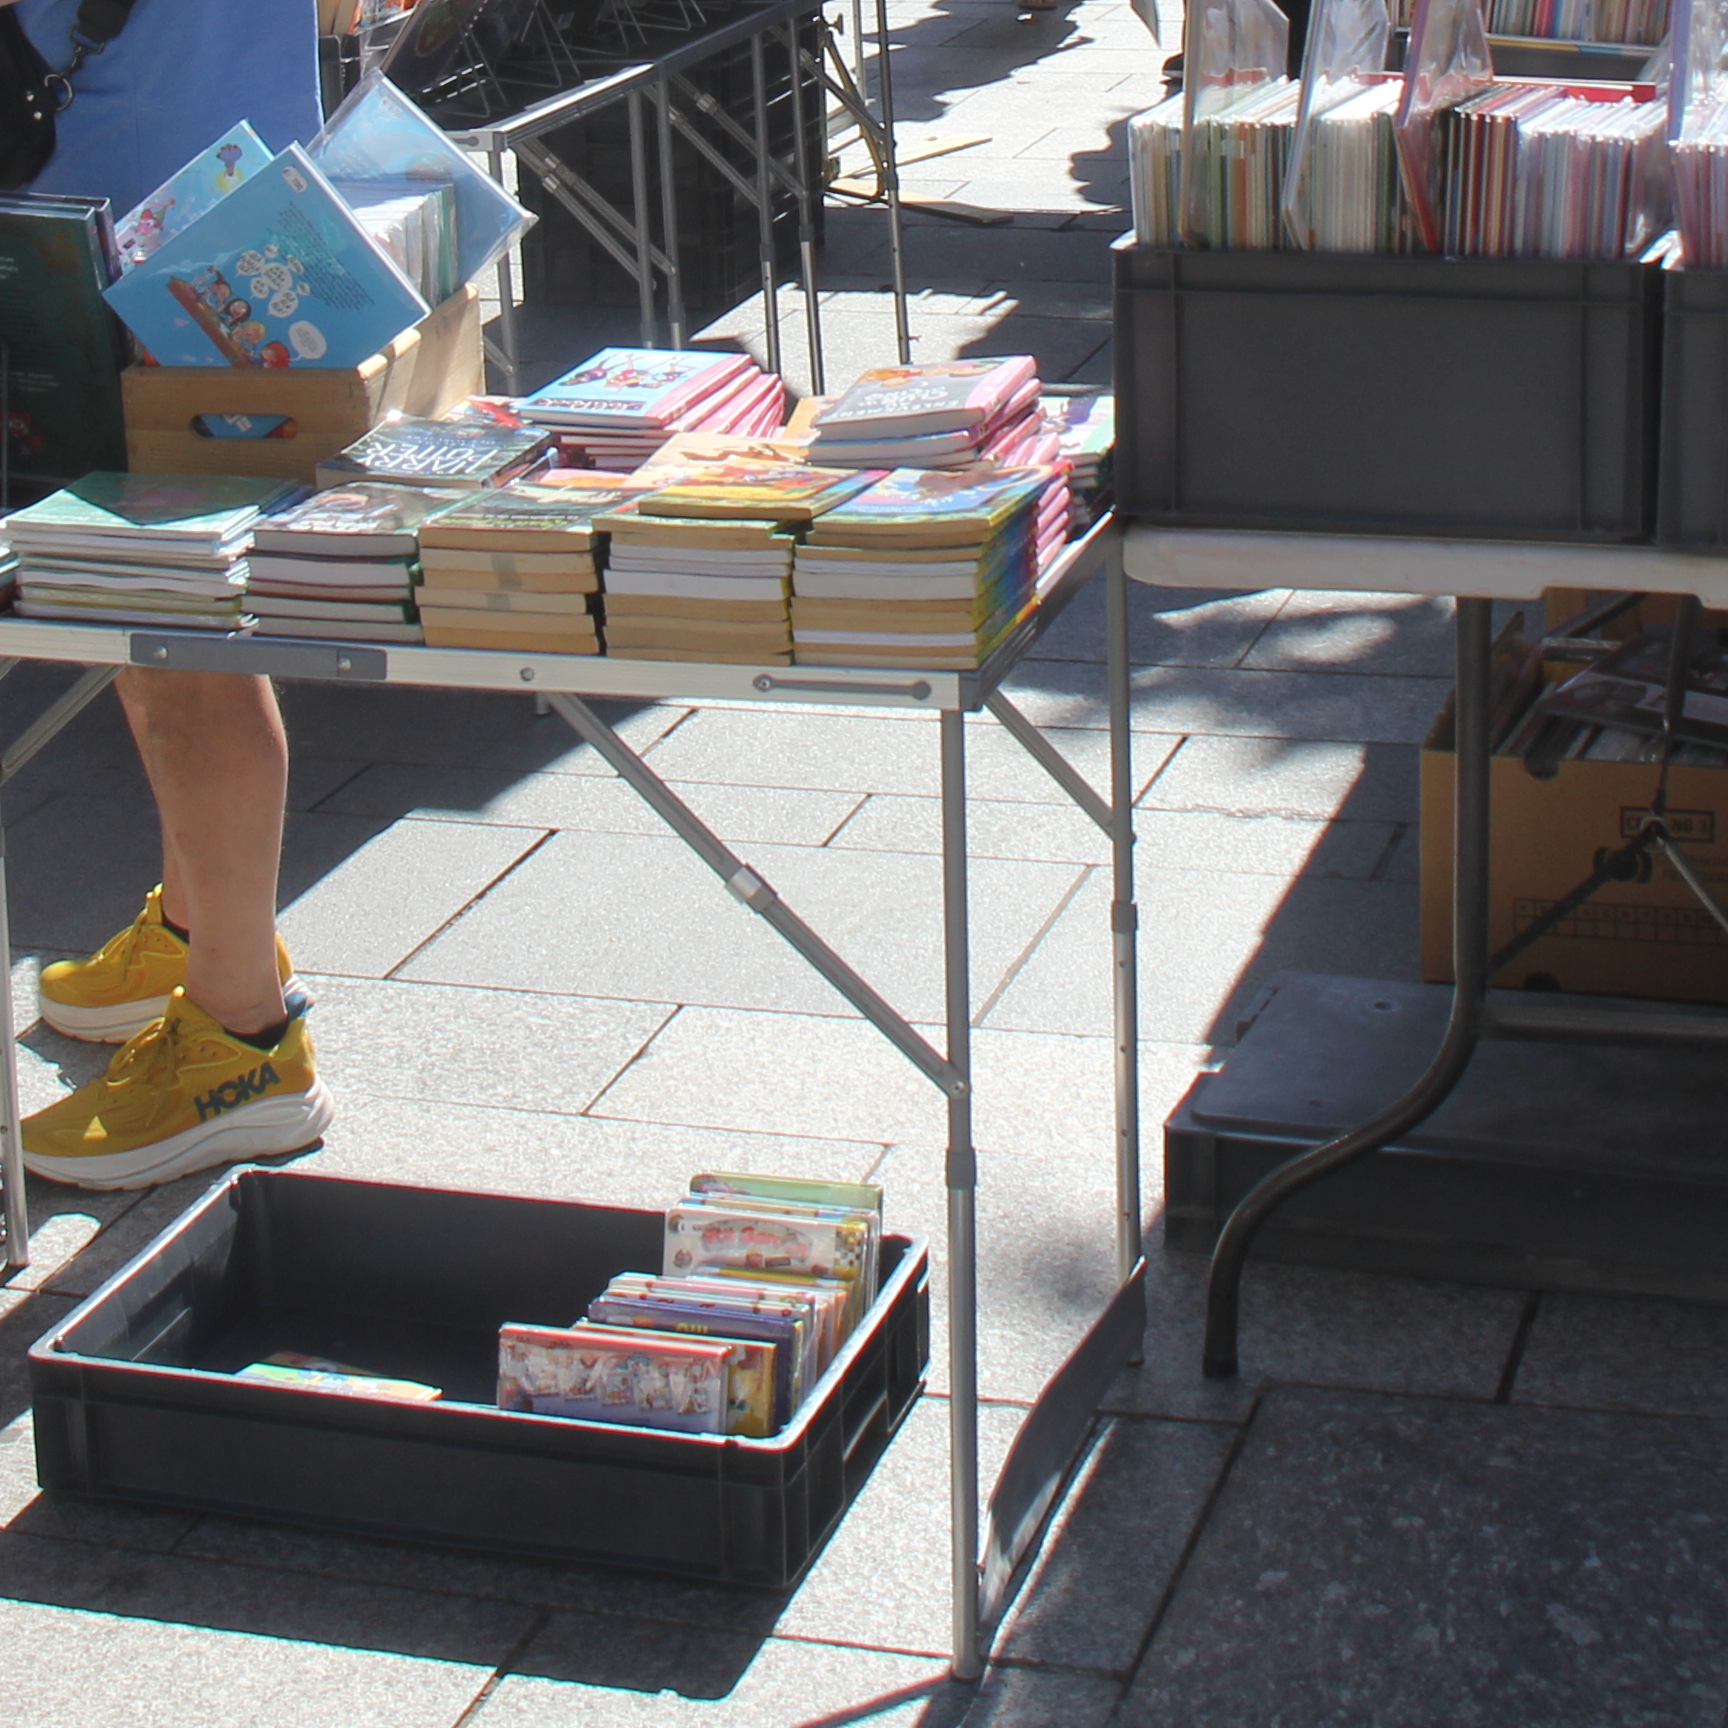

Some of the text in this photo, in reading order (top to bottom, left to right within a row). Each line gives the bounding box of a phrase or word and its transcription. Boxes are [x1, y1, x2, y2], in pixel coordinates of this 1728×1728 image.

[355, 452, 478, 474] HARRY
[366, 442, 498, 462] POTTER
[193, 1060, 281, 1123] HOKA
